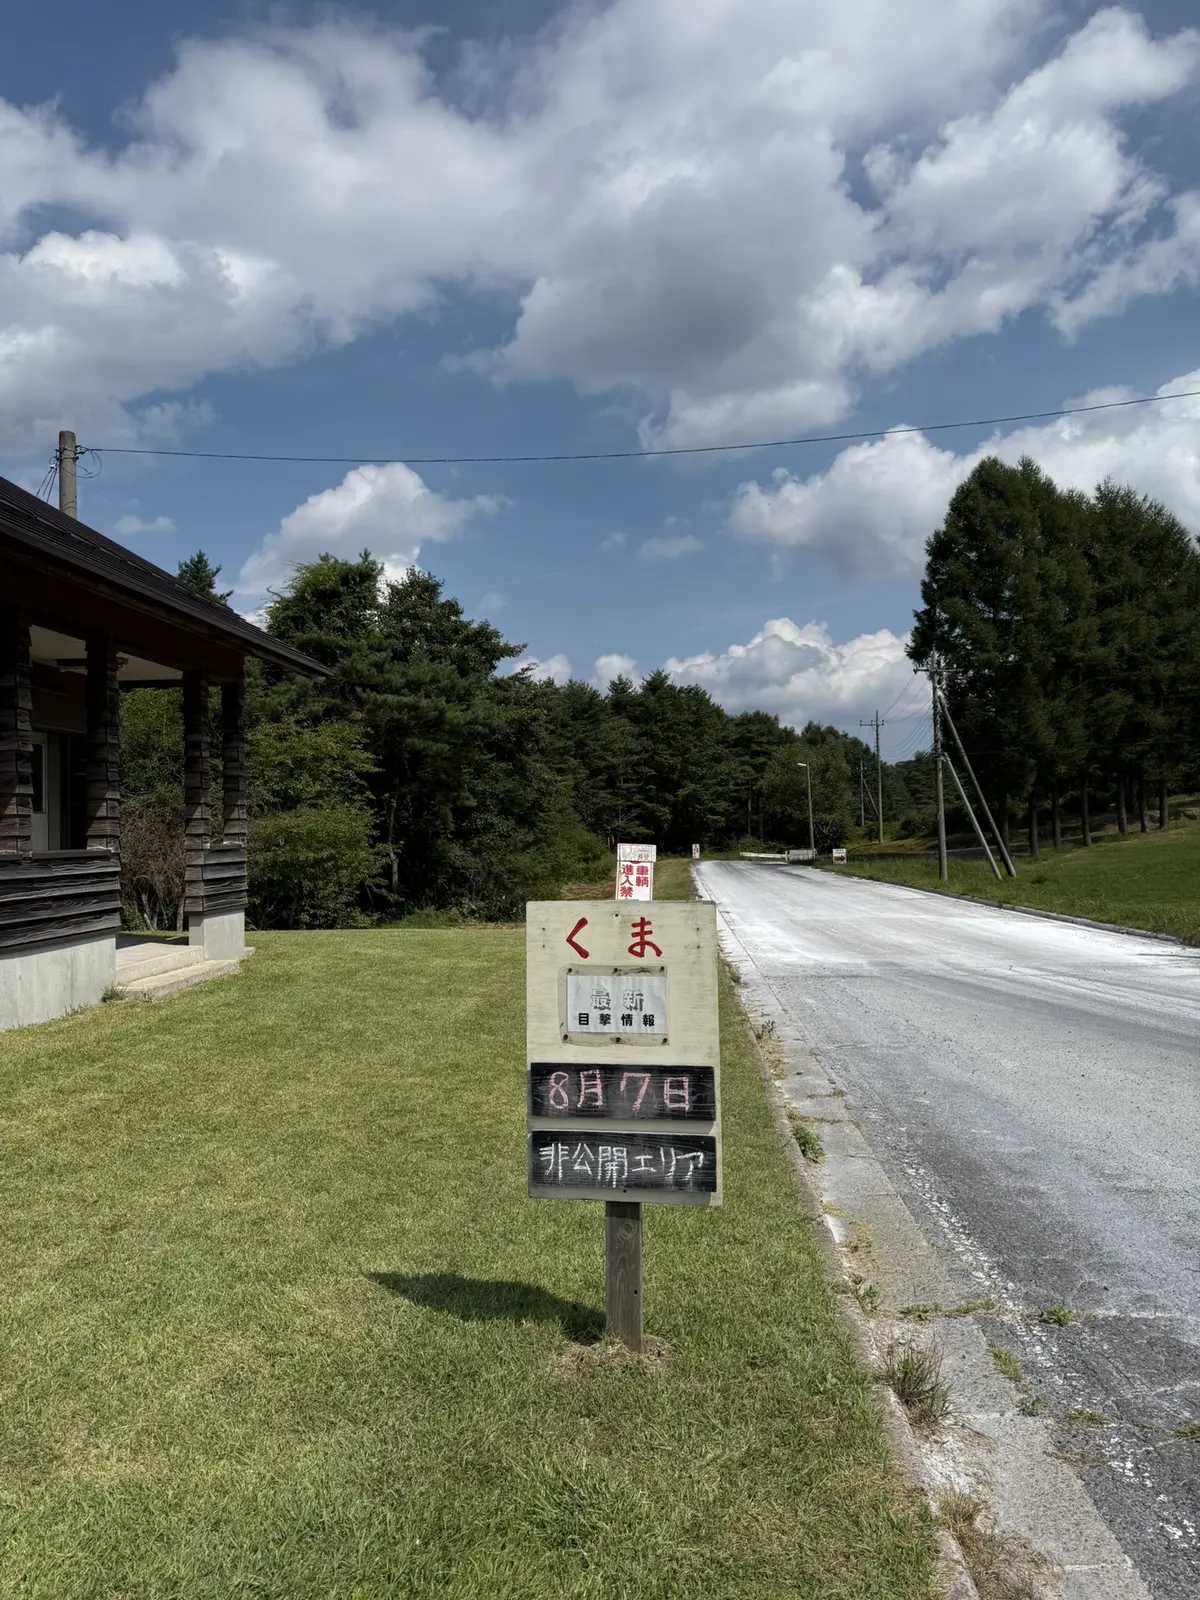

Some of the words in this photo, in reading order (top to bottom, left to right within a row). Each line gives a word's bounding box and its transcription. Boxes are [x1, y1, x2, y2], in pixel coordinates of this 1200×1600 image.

[620, 864, 634, 900] 進入禁
[566, 917, 663, 959] くま
[591, 988, 644, 1011] 最新
[578, 1013, 655, 1027] 目撃情報
[549, 1069, 690, 1112] 8月7日
[539, 1142, 705, 1188] 非公開エリア
